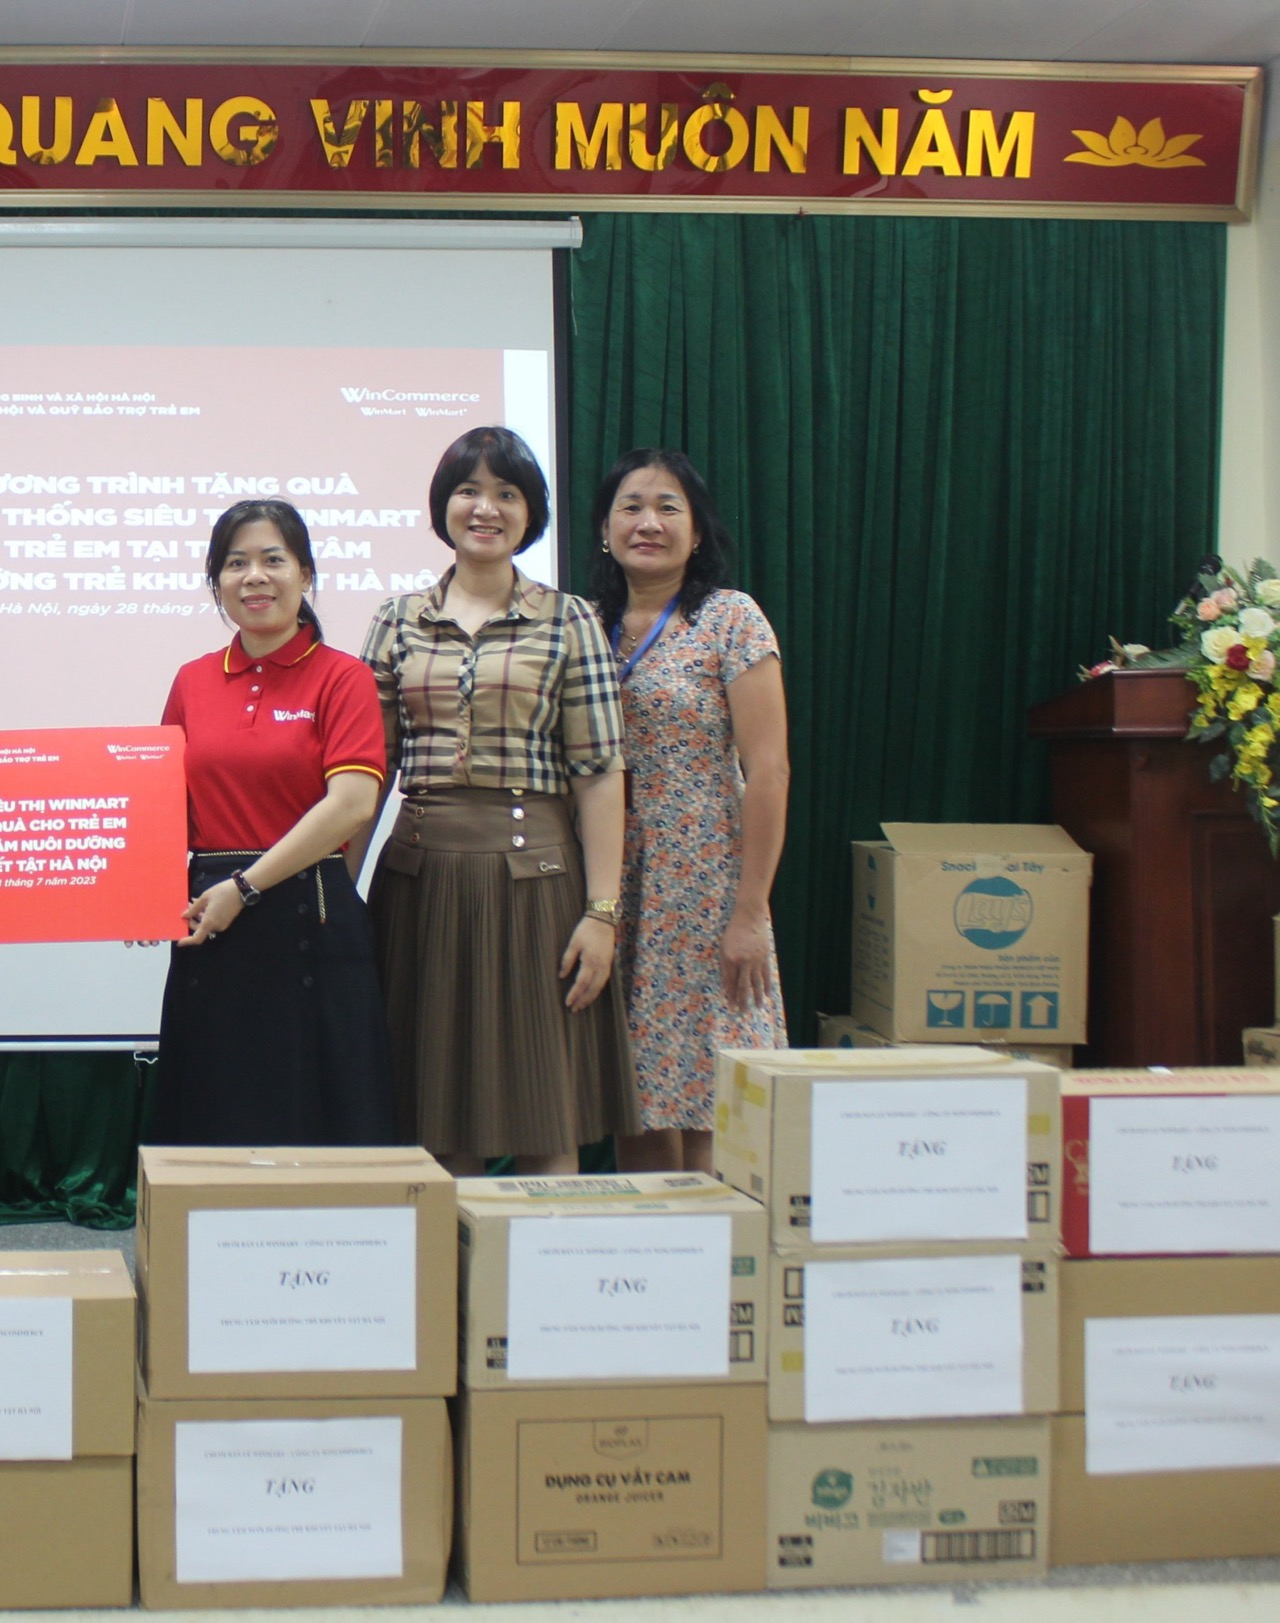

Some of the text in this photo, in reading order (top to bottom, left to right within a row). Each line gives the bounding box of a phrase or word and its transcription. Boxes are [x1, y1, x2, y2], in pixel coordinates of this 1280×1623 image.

[309, 99, 521, 171] VINH
[552, 81, 809, 175] MUÔN
[843, 88, 1037, 179] NĂM
[340, 387, 481, 404] WinCommerce
[86, 471, 184, 493] TRÌNH
[191, 472, 281, 500] TẶNG
[286, 472, 358, 494] QUÀ
[1, 501, 117, 526] THỐNG
[123, 503, 196, 526] SIÊU
[303, 508, 422, 528] INMART
[3, 534, 66, 557] TRẺ
[73, 540, 119, 558] EM
[126, 540, 177, 561] TẠI
[62, 565, 125, 590] TRẺ
[336, 567, 385, 592] HÀ
[27, 602, 60, 616] Nội,
[67, 602, 111, 616] ngày
[114, 602, 138, 614] 28
[143, 602, 193, 616] tháng
[198, 603, 209, 613] 7
[18, 800, 44, 813] THỊ
[49, 797, 128, 810] WINMART
[29, 818, 64, 831] CHO
[68, 813, 99, 830] TRẺ
[103, 817, 126, 828] EM
[21, 836, 61, 851] NUÔI
[65, 834, 125, 850] DƯỠNG
[16, 856, 46, 874] TẬT
[49, 855, 73, 870] HÀ
[77, 854, 106, 872] NỘI
[4, 878, 33, 888] tháng
[37, 877, 43, 885] 7
[45, 876, 67, 885] năm
[69, 876, 96, 885] 2023
[279, 1268, 330, 1290] TẶNG
[597, 1276, 649, 1298] TẶNG
[265, 1476, 316, 1499] TẶNG
[544, 1465, 691, 1491] DỤNG CỤ VẮT CAM
